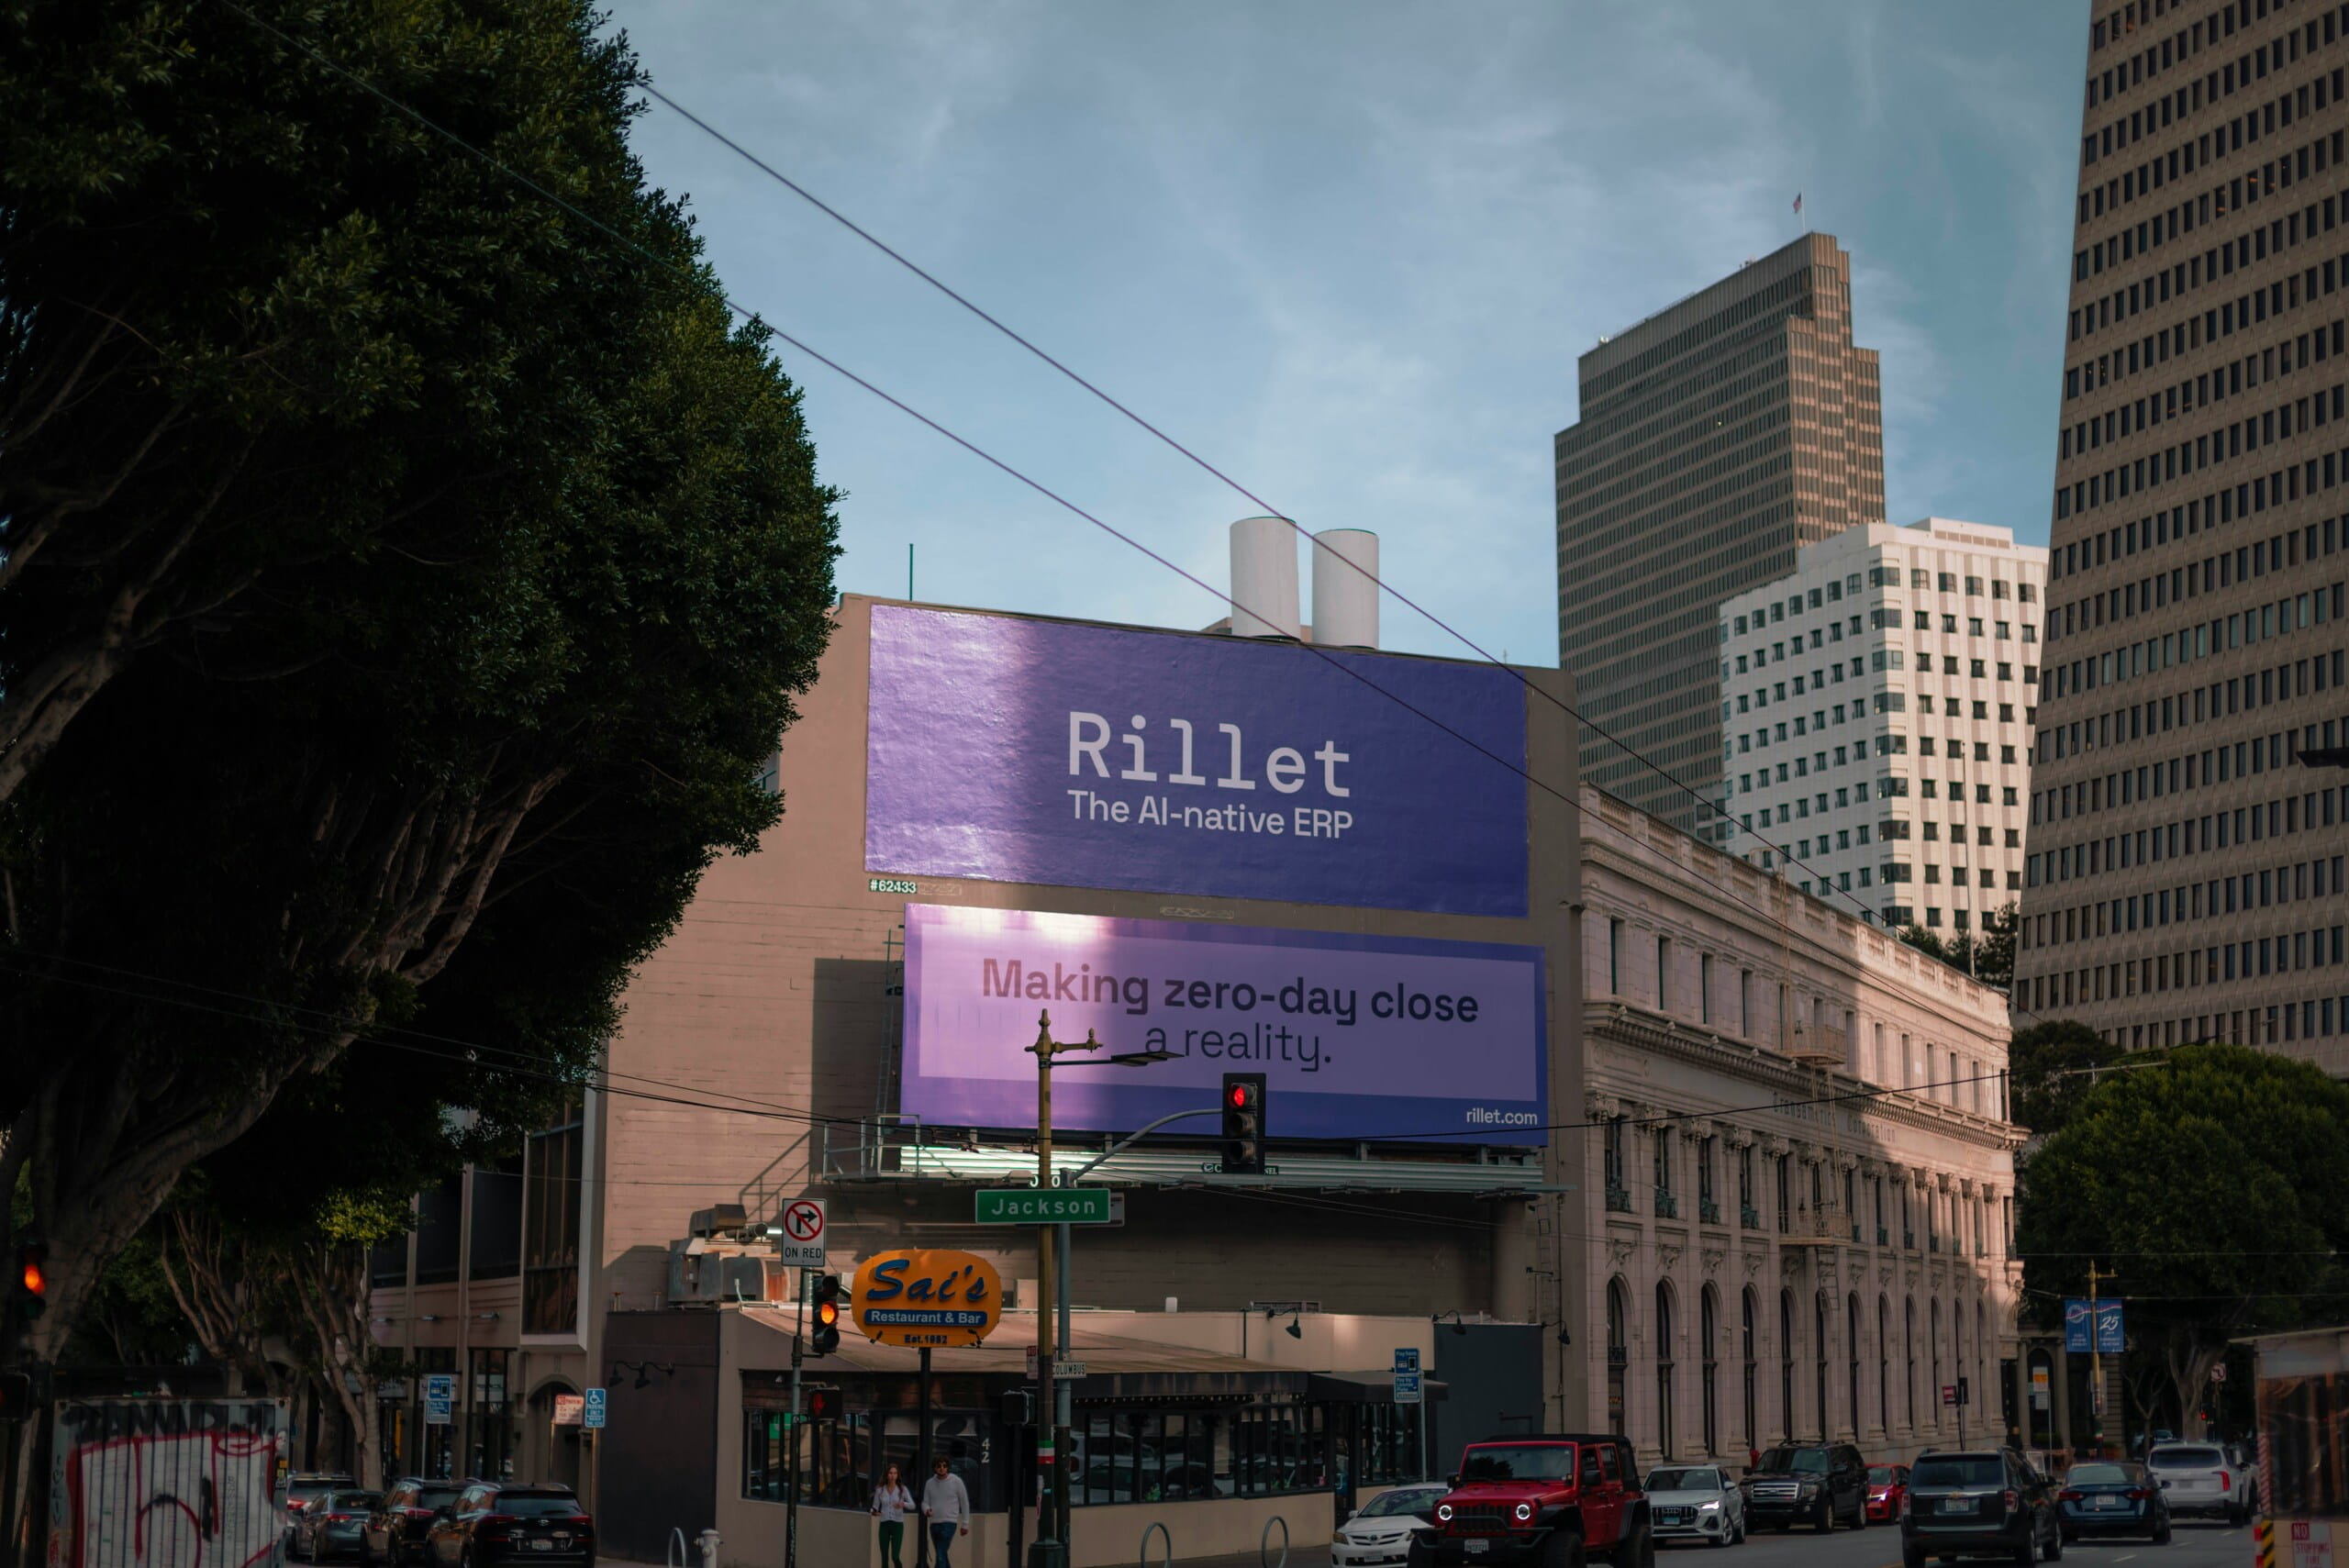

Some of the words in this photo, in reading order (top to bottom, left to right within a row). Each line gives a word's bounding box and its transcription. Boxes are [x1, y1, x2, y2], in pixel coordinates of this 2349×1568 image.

[1069, 711, 1350, 797] Rillet
[1066, 789, 1130, 823] The
[1138, 795, 1285, 835] AI-native
[1294, 807, 1353, 839] ERP
[870, 879, 917, 894] #62433
[983, 958, 1149, 1015] Making
[1164, 976, 1356, 1026] zero-day
[1371, 983, 1478, 1022] close
[1145, 1028, 1166, 1055] a
[1185, 1022, 1331, 1072] reality.
[1466, 1107, 1538, 1125] rillet.com
[991, 1198, 1096, 1215] Jackson
[785, 1247, 798, 1258] ON
[802, 1248, 822, 1259] RED
[866, 1259, 988, 1301] Sai's
[871, 1311, 941, 1322] Restaurant
[945, 1312, 954, 1323] &
[958, 1312, 982, 1324] Bar
[2099, 1316, 2121, 1330] 25
[2293, 1524, 2309, 1539] NO
